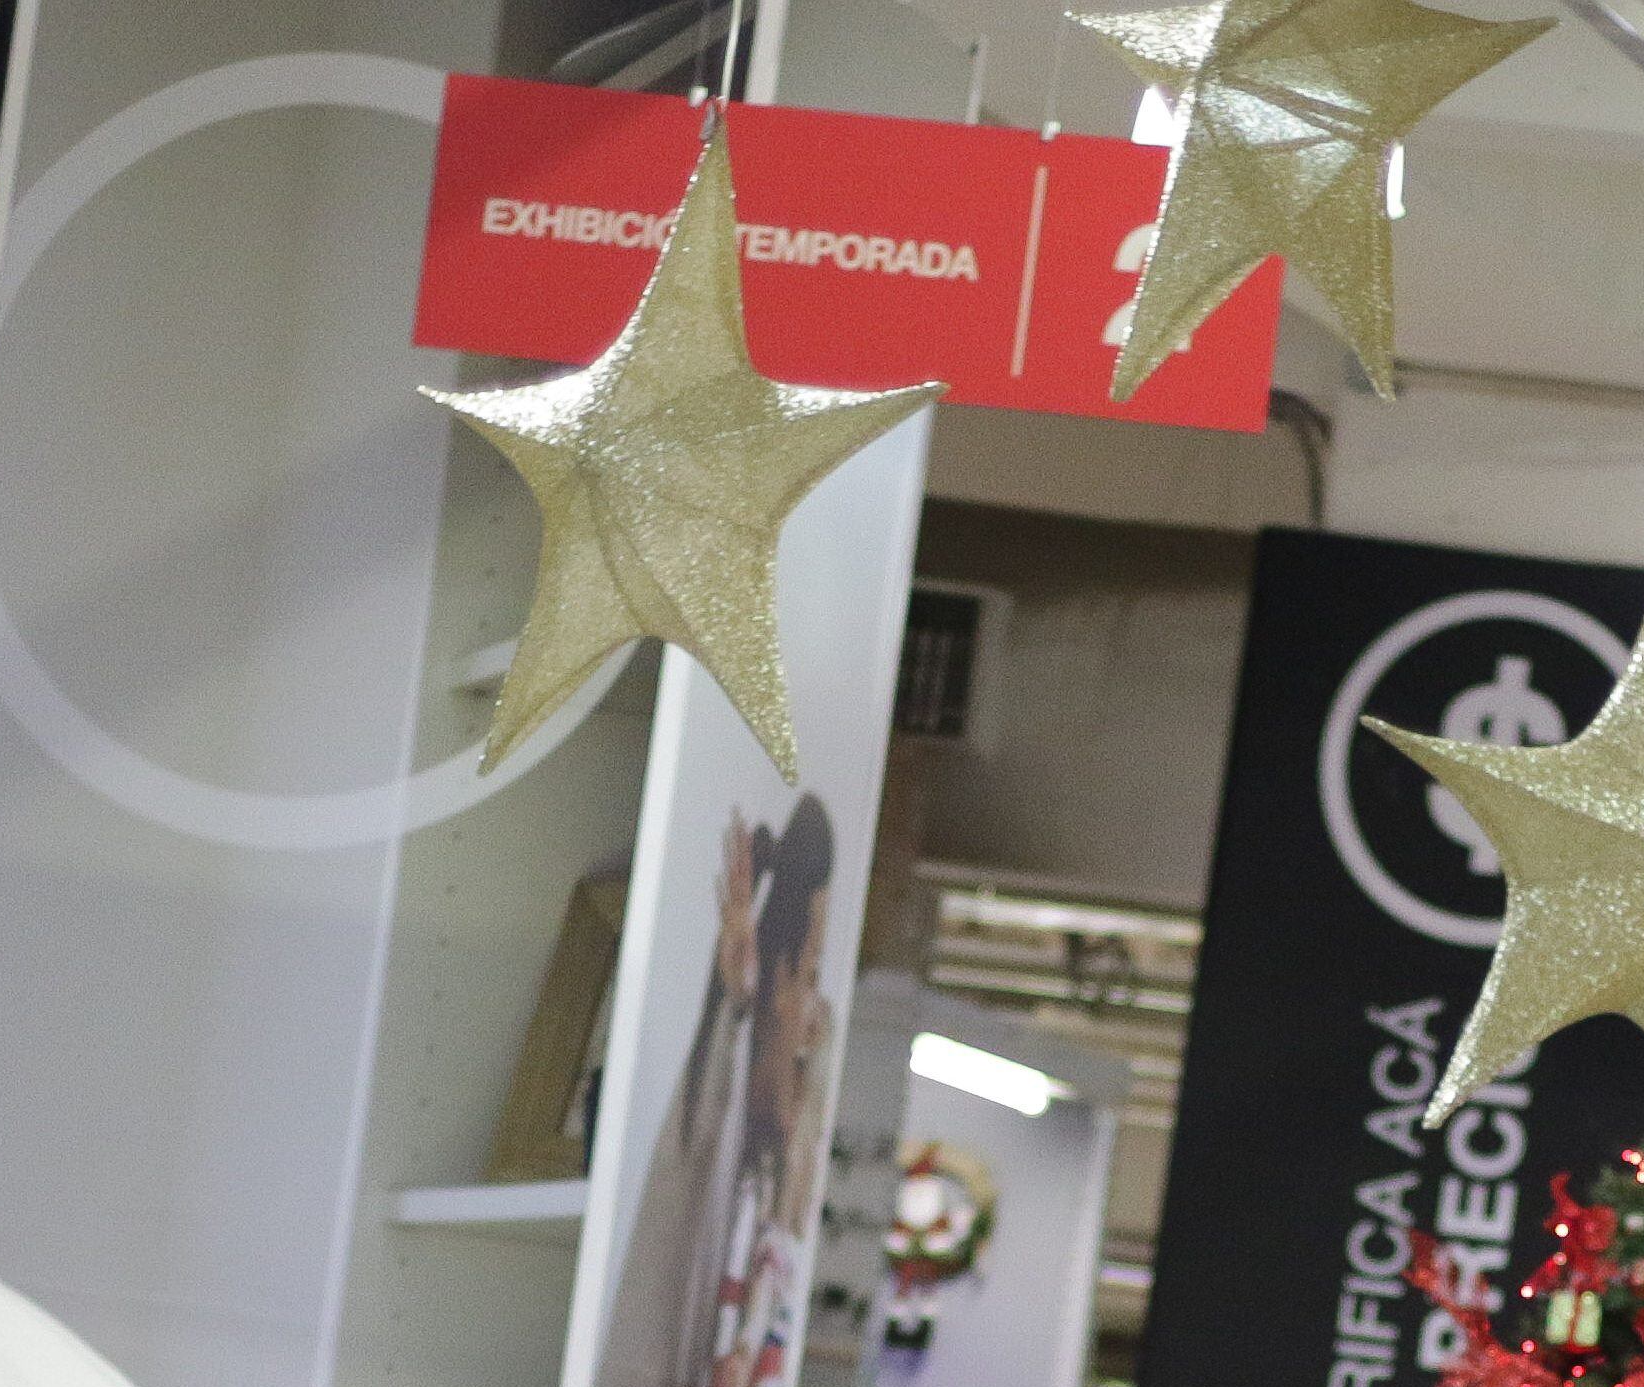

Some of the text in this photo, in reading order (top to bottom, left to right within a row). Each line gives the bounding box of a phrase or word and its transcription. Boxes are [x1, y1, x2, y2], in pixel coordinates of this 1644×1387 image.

[481, 196, 980, 282] EXHIBICI TEMPORADA
[1364, 997, 1444, 1158] ACÁ
[1418, 1044, 1540, 1370] PRECI
